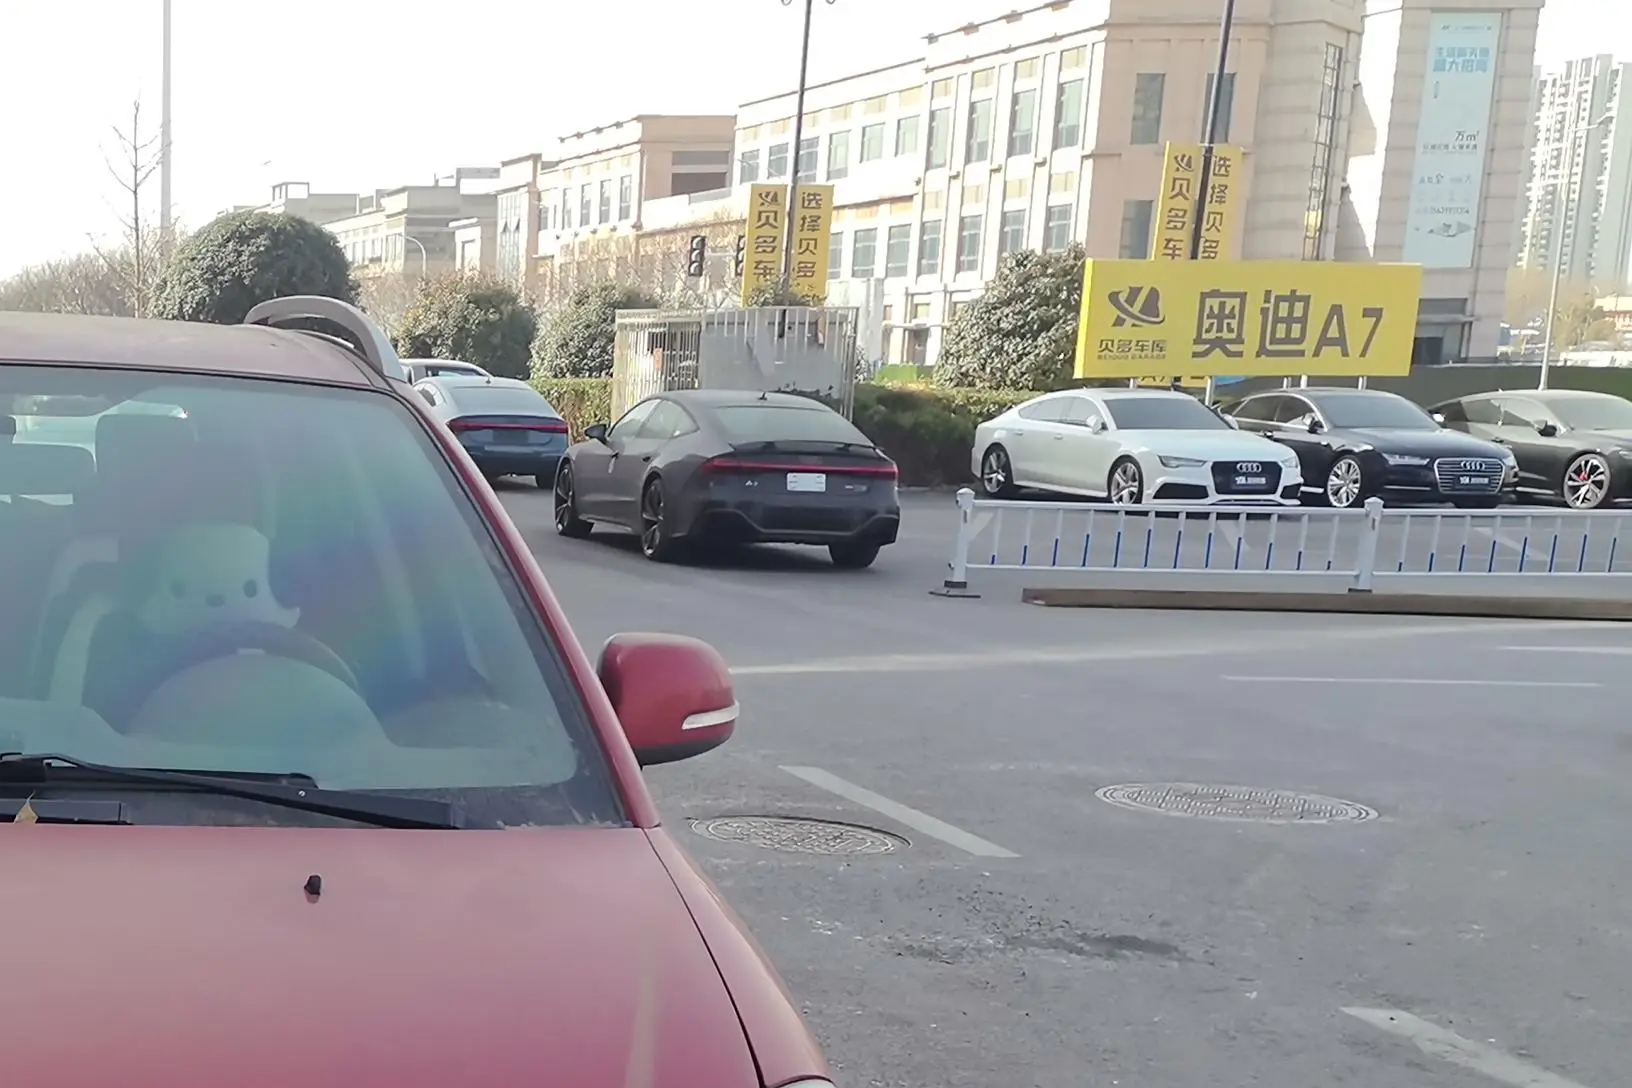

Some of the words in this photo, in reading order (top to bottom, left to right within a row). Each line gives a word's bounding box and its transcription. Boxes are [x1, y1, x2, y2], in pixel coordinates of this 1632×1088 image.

[796, 192, 822, 278] 选择贝多
[1098, 339, 1166, 352] 贝多车库
